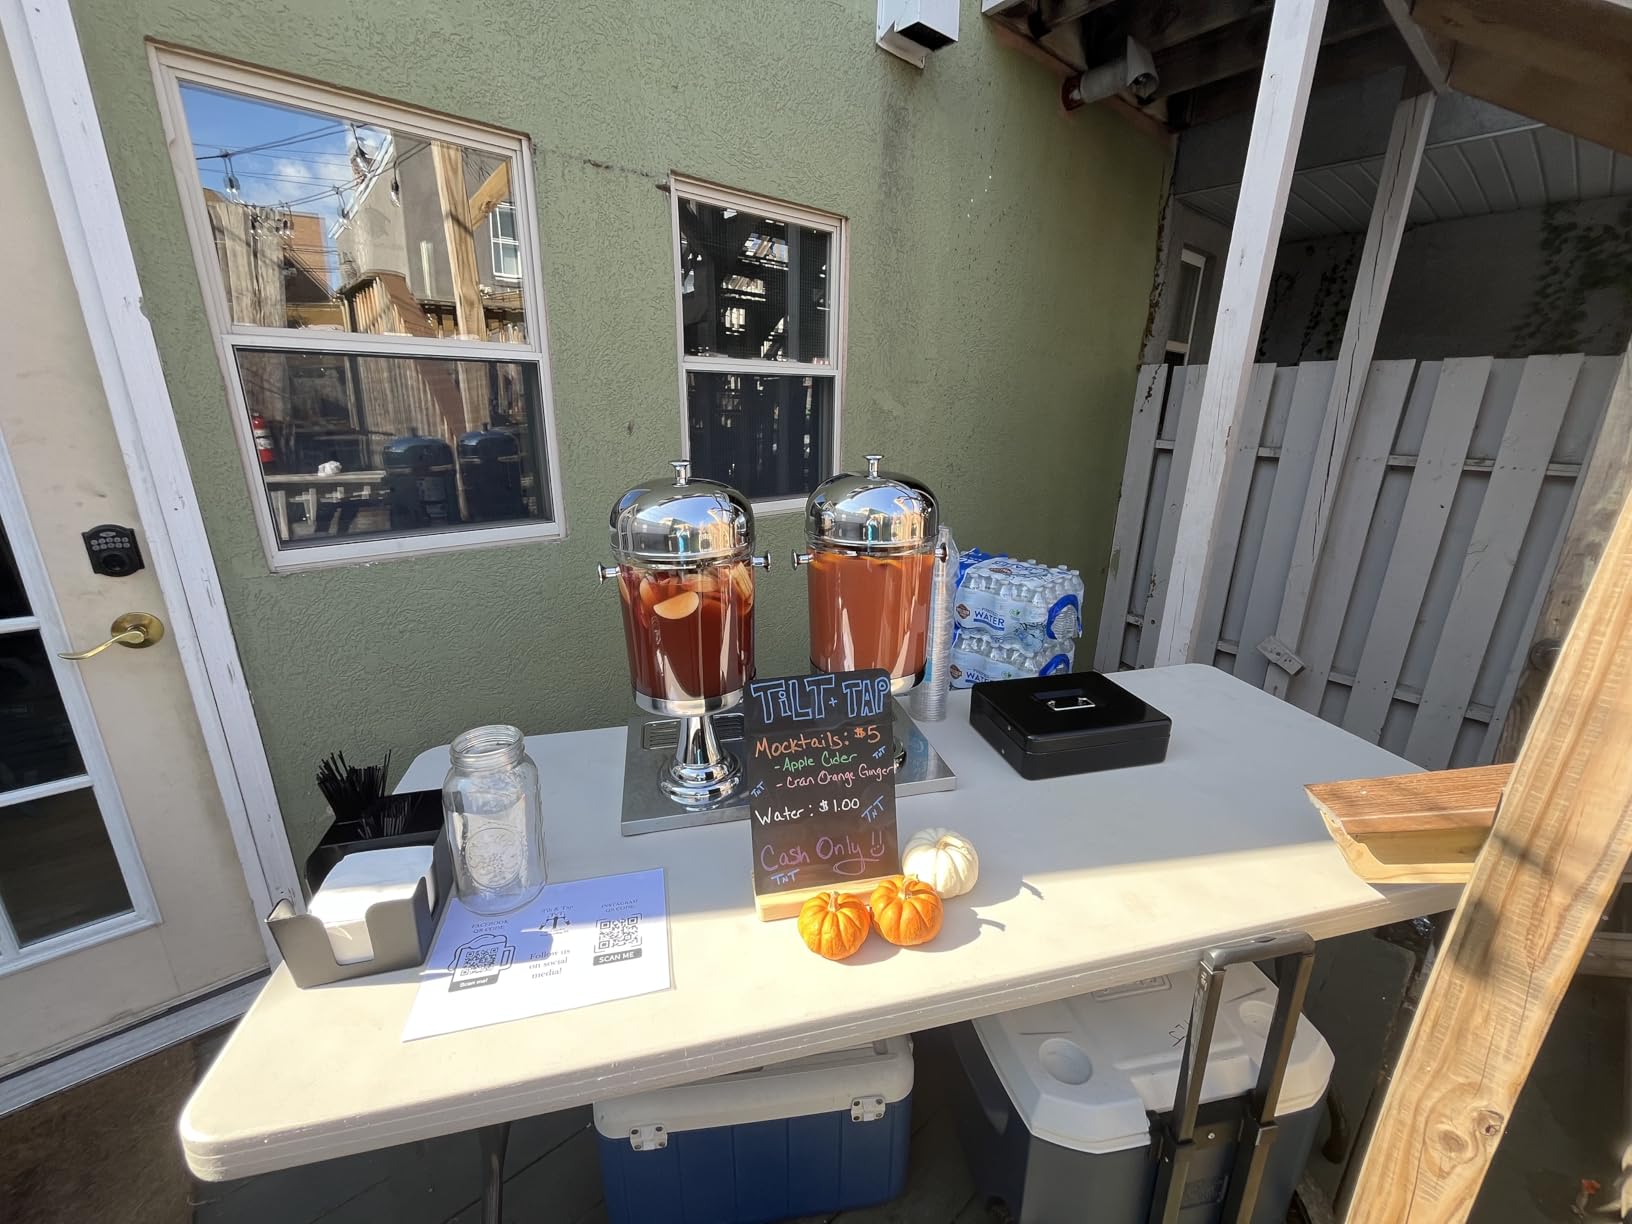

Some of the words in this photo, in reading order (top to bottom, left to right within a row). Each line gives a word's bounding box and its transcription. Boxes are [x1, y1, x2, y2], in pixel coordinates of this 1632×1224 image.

[974, 610, 1005, 626] WATER
[842, 676, 890, 717] TAP
[755, 731, 850, 760] Mocktails:
[854, 724, 881, 744] $5
[821, 751, 858, 766] Cider
[786, 776, 814, 788] Cran
[817, 770, 856, 788] Orange
[858, 763, 895, 781] Ginger
[760, 844, 810, 872] Cash
[816, 835, 867, 876] Only
[530, 950, 559, 960] Follow
[543, 956, 568, 968] social
[599, 954, 621, 963] SCAN
[622, 951, 635, 959] ME
